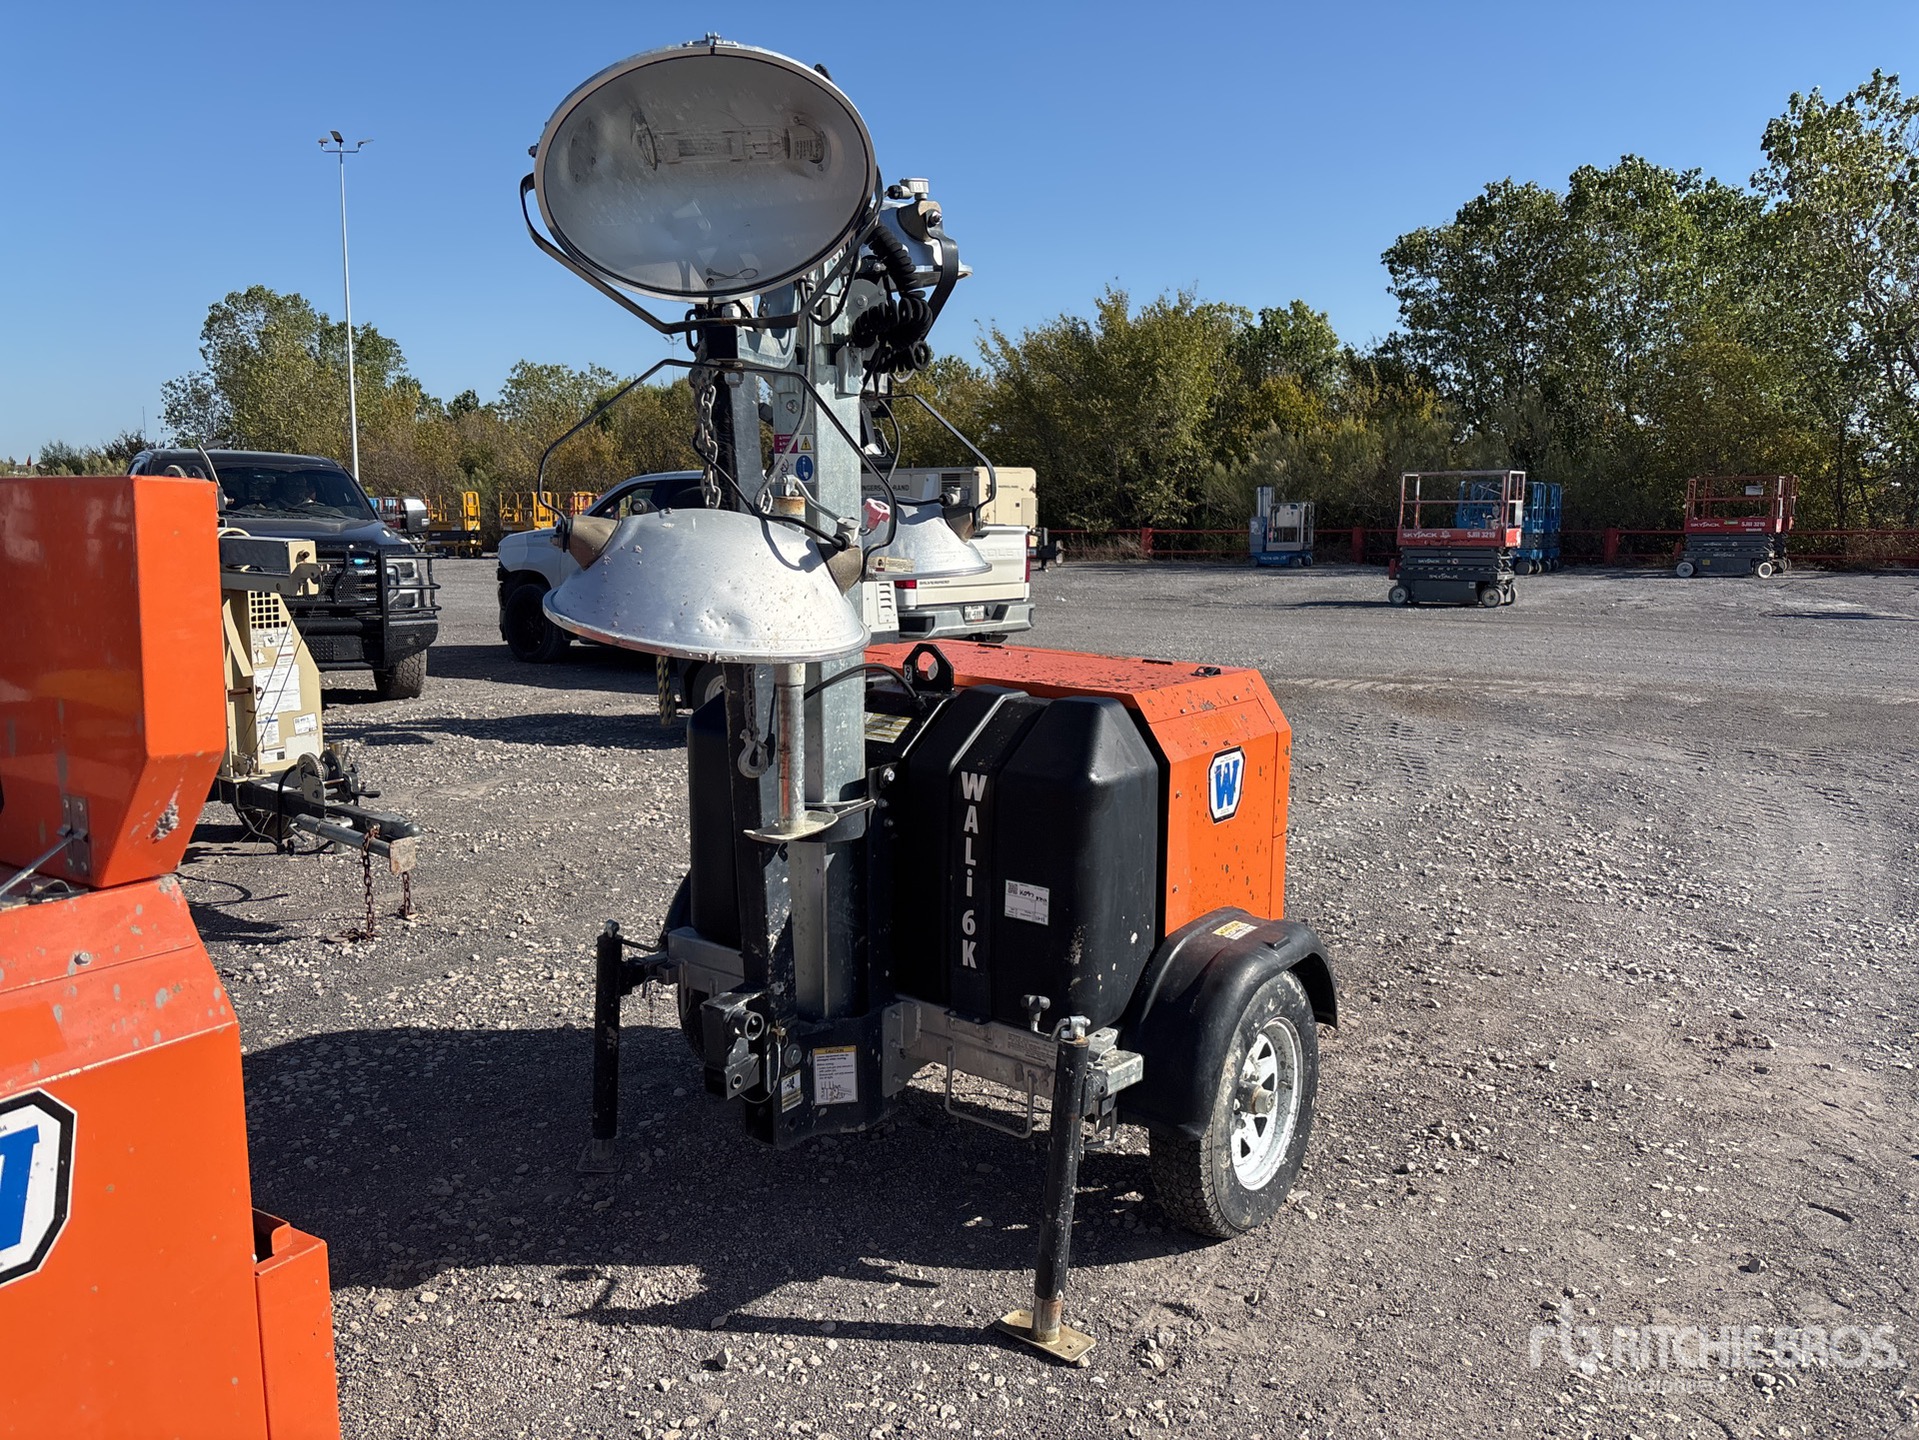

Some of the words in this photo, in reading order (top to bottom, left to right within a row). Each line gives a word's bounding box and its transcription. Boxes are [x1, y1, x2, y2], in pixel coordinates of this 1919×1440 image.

[1402, 530, 1438, 539] SKYJACK
[1214, 759, 1240, 810] W
[962, 909, 978, 969] 6K
